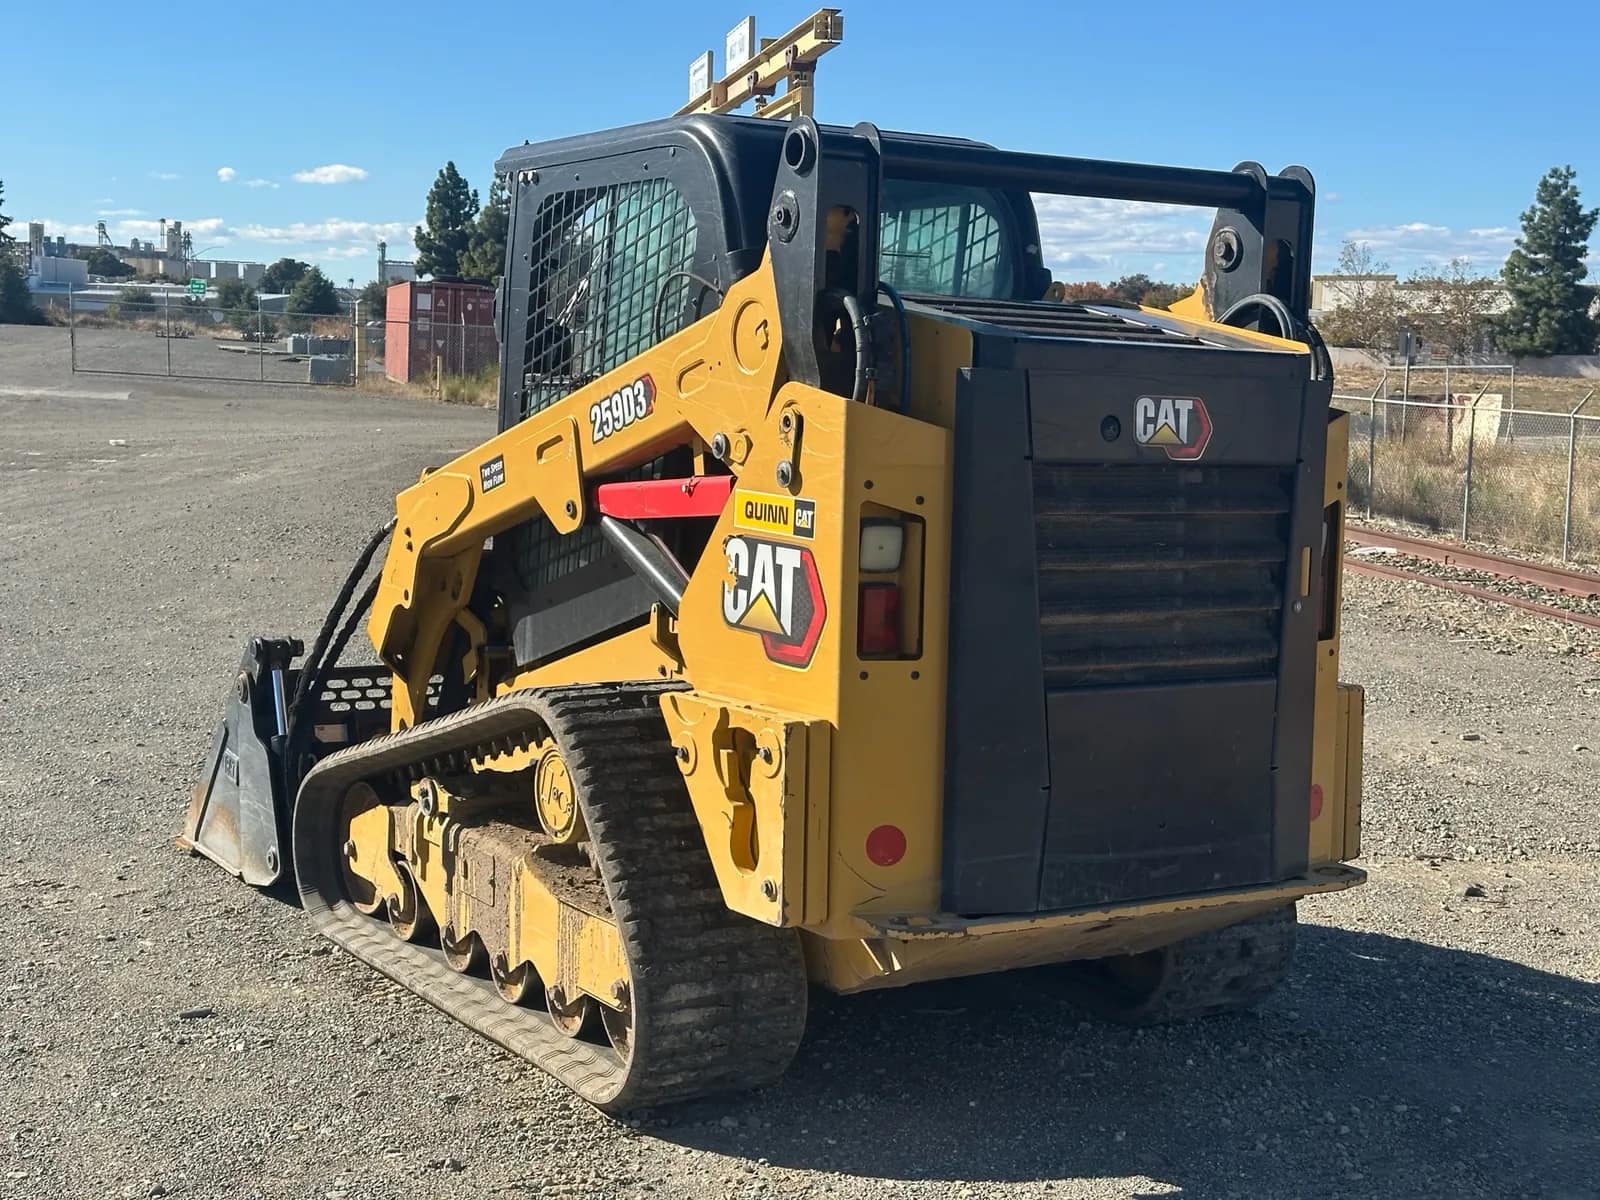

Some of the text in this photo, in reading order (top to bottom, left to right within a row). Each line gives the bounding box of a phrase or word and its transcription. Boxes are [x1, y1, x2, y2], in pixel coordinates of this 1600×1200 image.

[590, 379, 647, 442] 259D3
[1136, 397, 1194, 444] CAT
[745, 501, 814, 529] QUINN CAT
[724, 538, 801, 637] CAT
